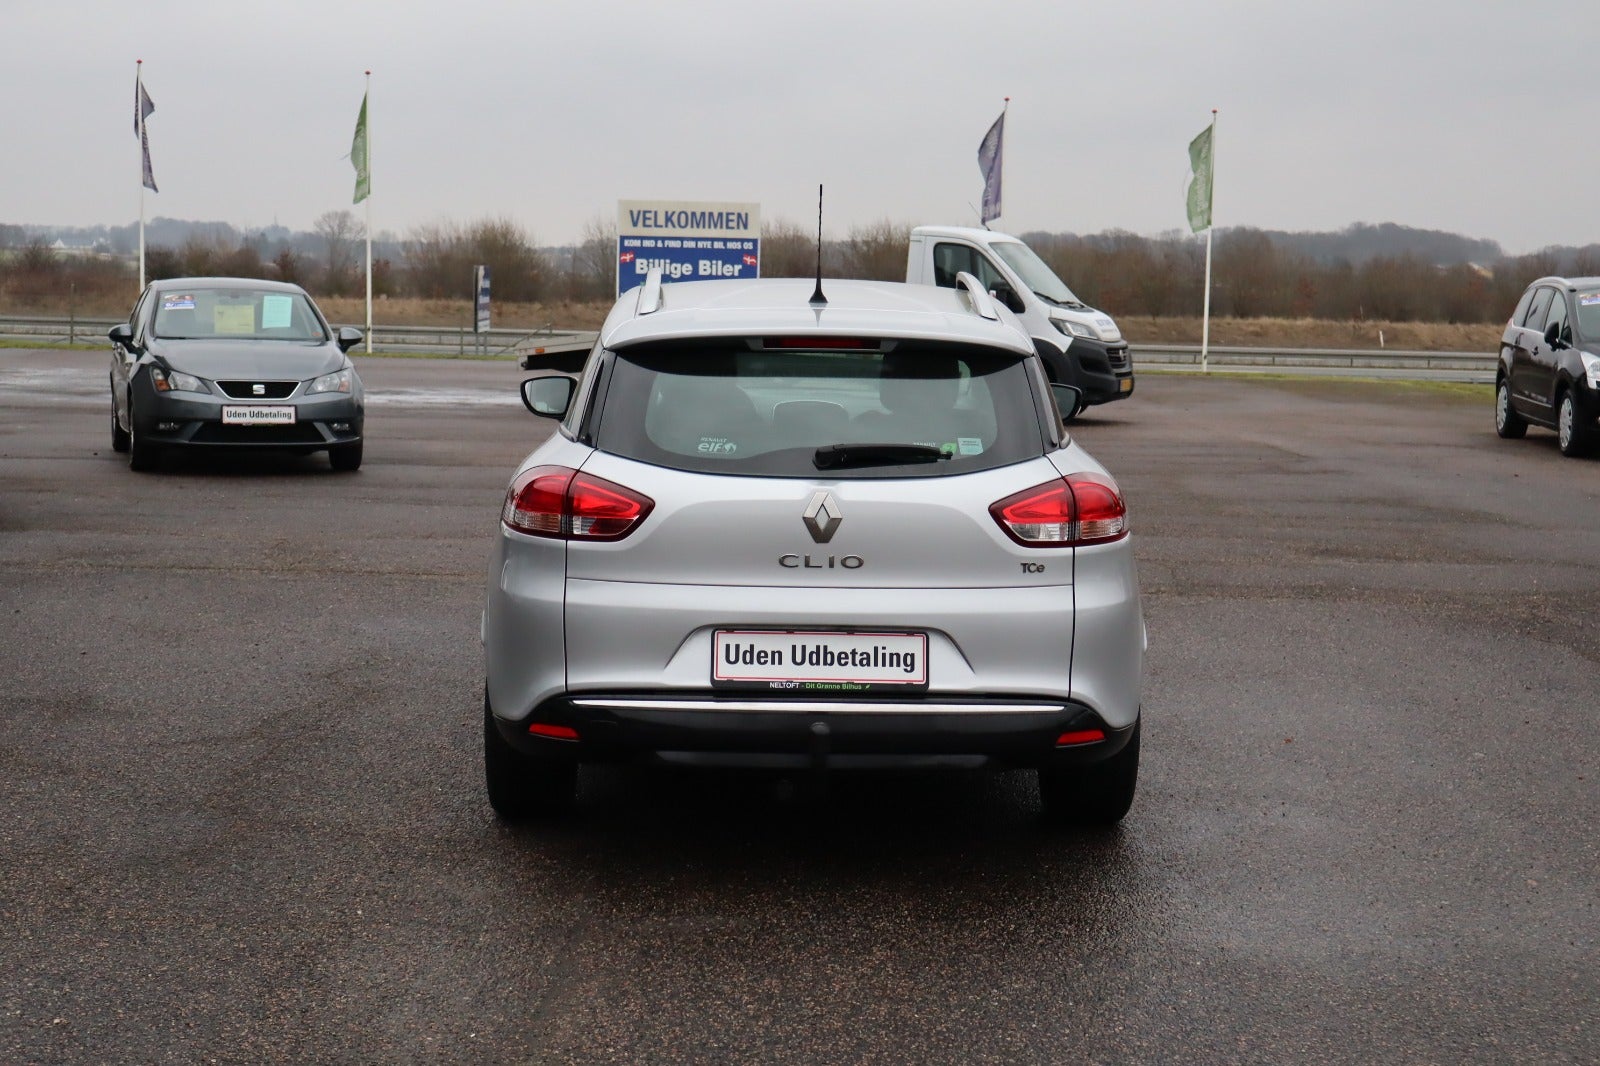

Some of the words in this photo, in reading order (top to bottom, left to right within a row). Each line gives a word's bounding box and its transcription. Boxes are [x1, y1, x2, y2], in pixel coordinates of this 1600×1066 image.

[629, 209, 749, 230] VELKOMMEN
[624, 239, 641, 247] KOM
[635, 258, 693, 278] Billige
[698, 259, 742, 276] Biler
[226, 410, 247, 418] Uden
[249, 410, 292, 419] Udbetaling
[778, 554, 865, 569] CLIO
[1020, 562, 1045, 574] TCe
[724, 643, 783, 665] Uden
[791, 644, 916, 673] Udbetaling
